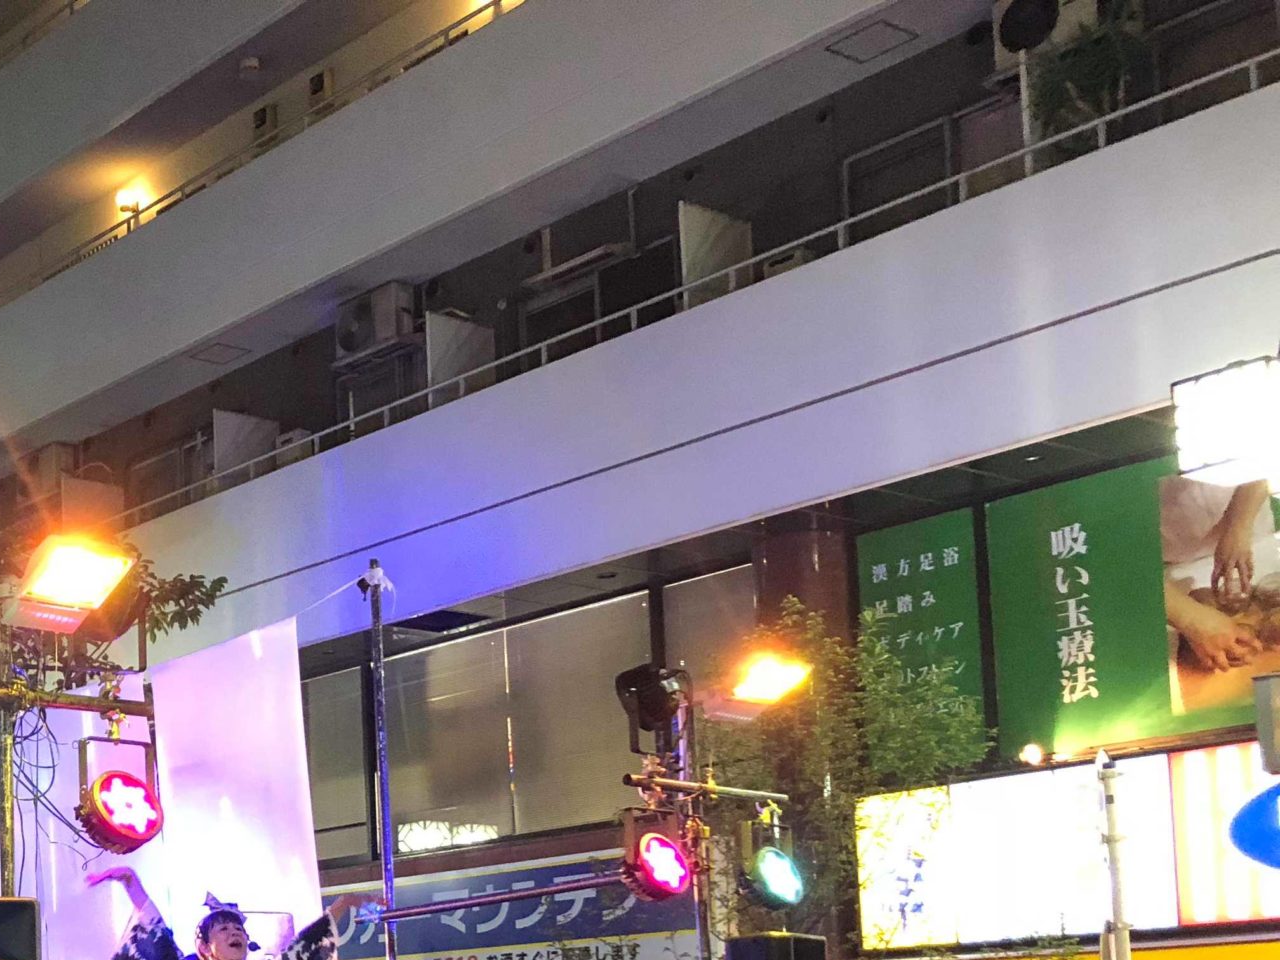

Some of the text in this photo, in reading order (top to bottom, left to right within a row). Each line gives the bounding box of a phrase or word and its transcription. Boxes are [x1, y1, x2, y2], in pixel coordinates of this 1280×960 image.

[872, 546, 960, 584] 漢方足浴
[875, 590, 937, 618] 足踏み
[1050, 522, 1100, 704] 吸い玉療法
